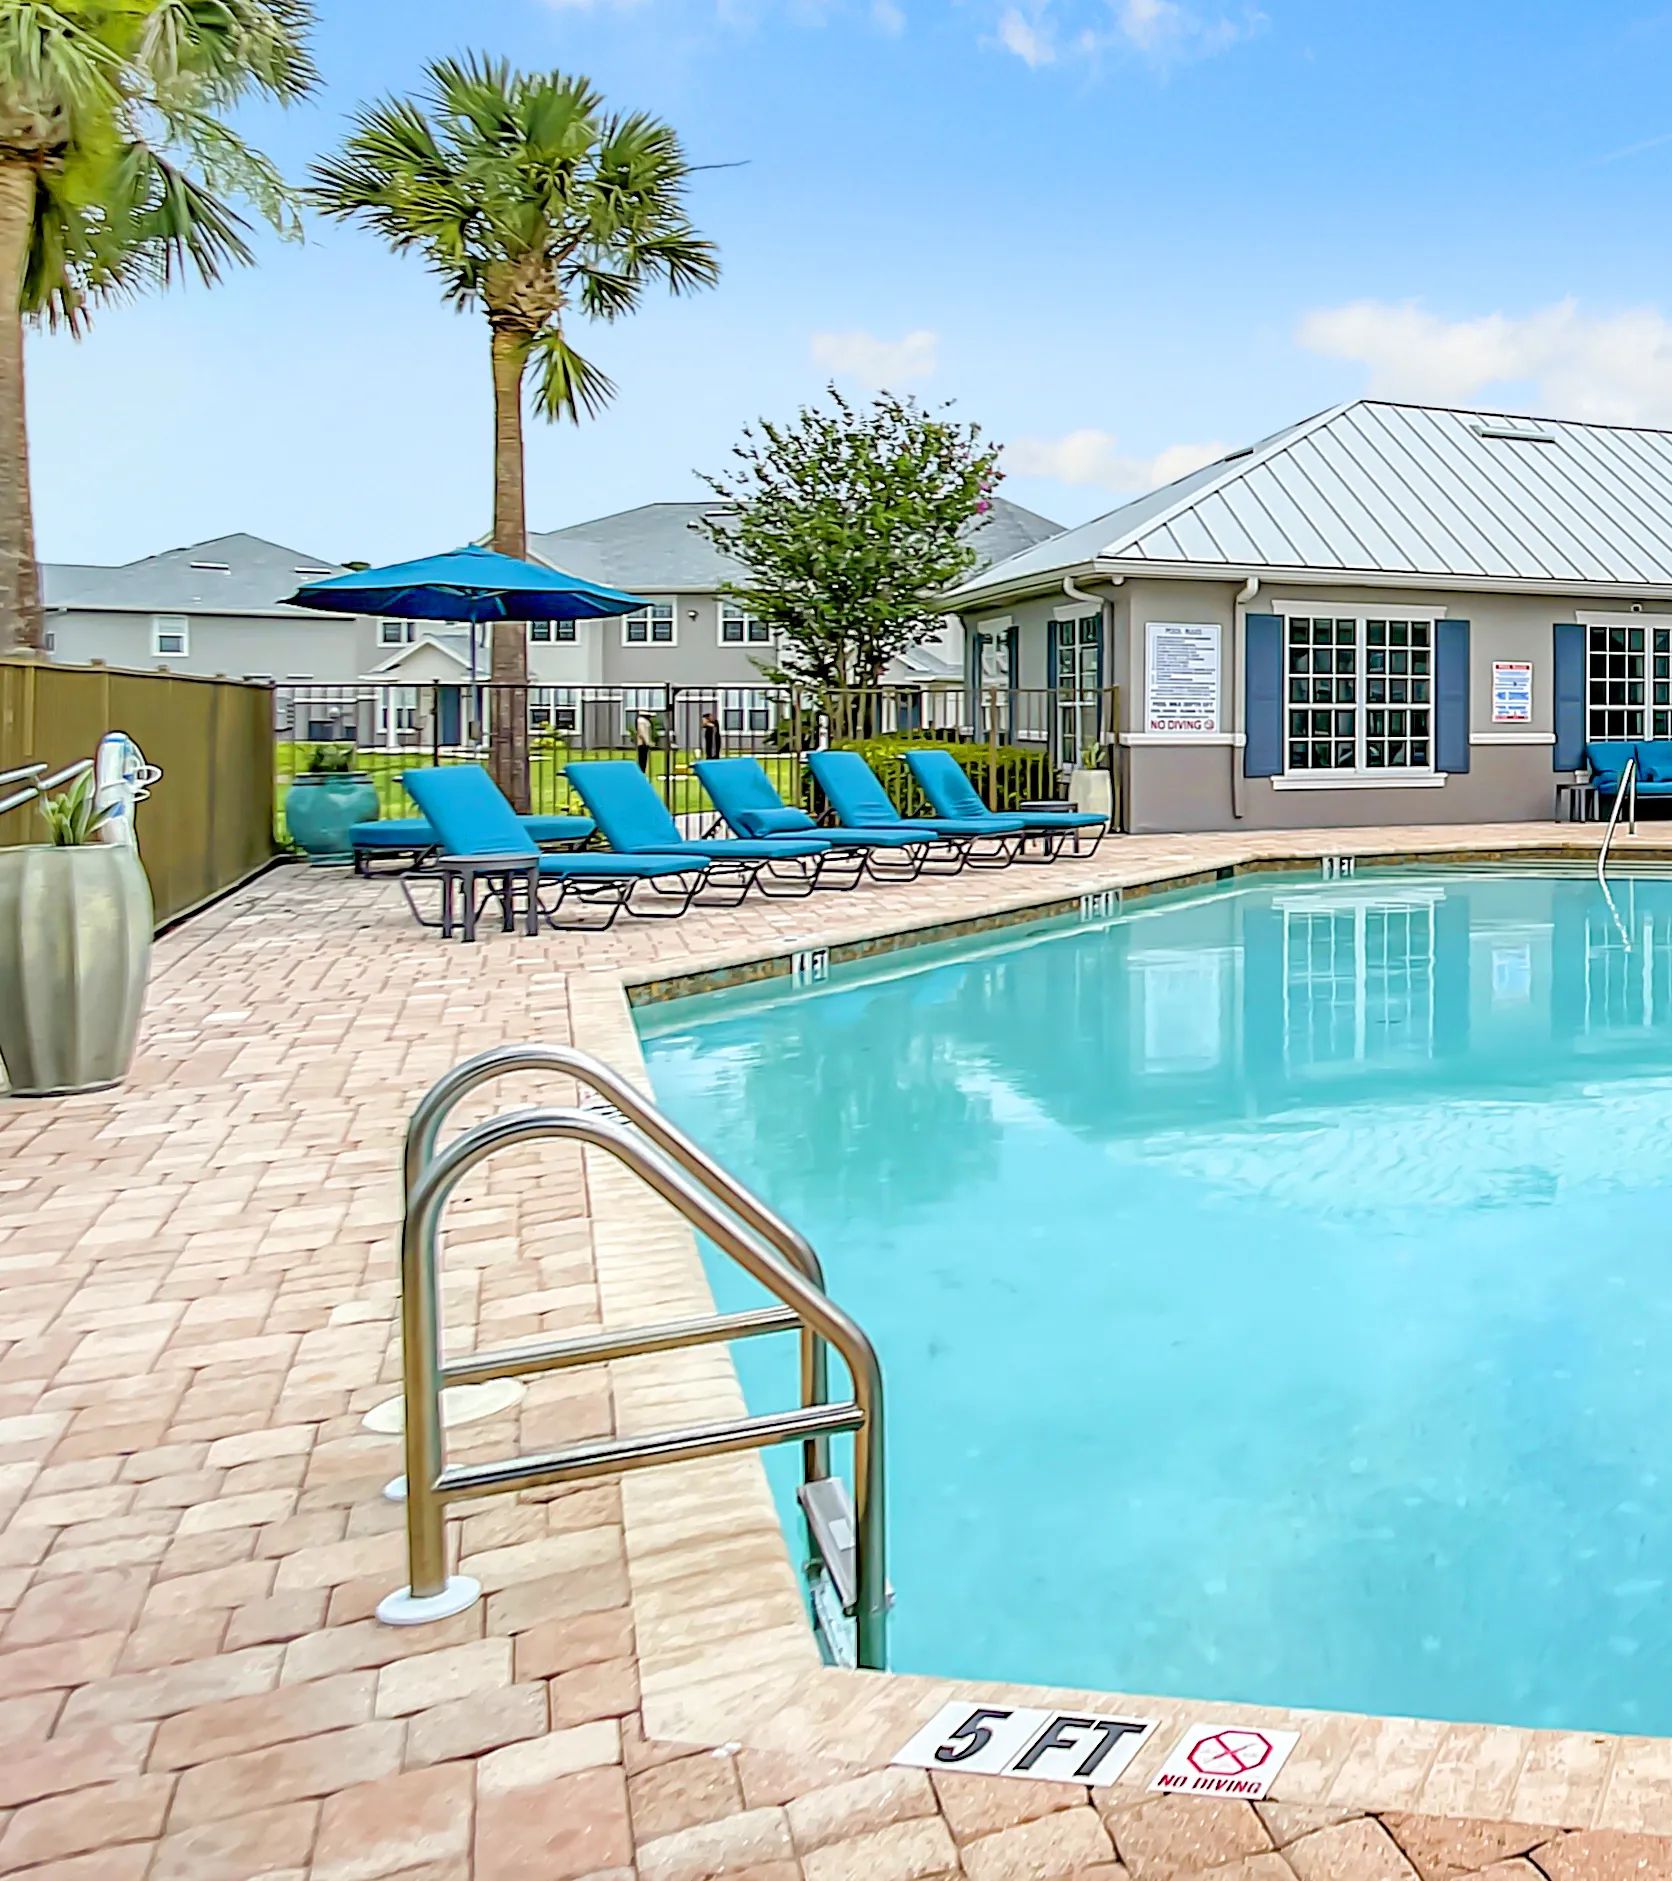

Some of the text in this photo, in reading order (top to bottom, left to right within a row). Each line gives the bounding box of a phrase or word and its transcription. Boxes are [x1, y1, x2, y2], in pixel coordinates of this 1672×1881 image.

[1150, 719, 1202, 730] NO DIVING
[934, 1708, 1146, 1776] 5 FT
[1157, 1774, 1263, 1794] NO DIVING
